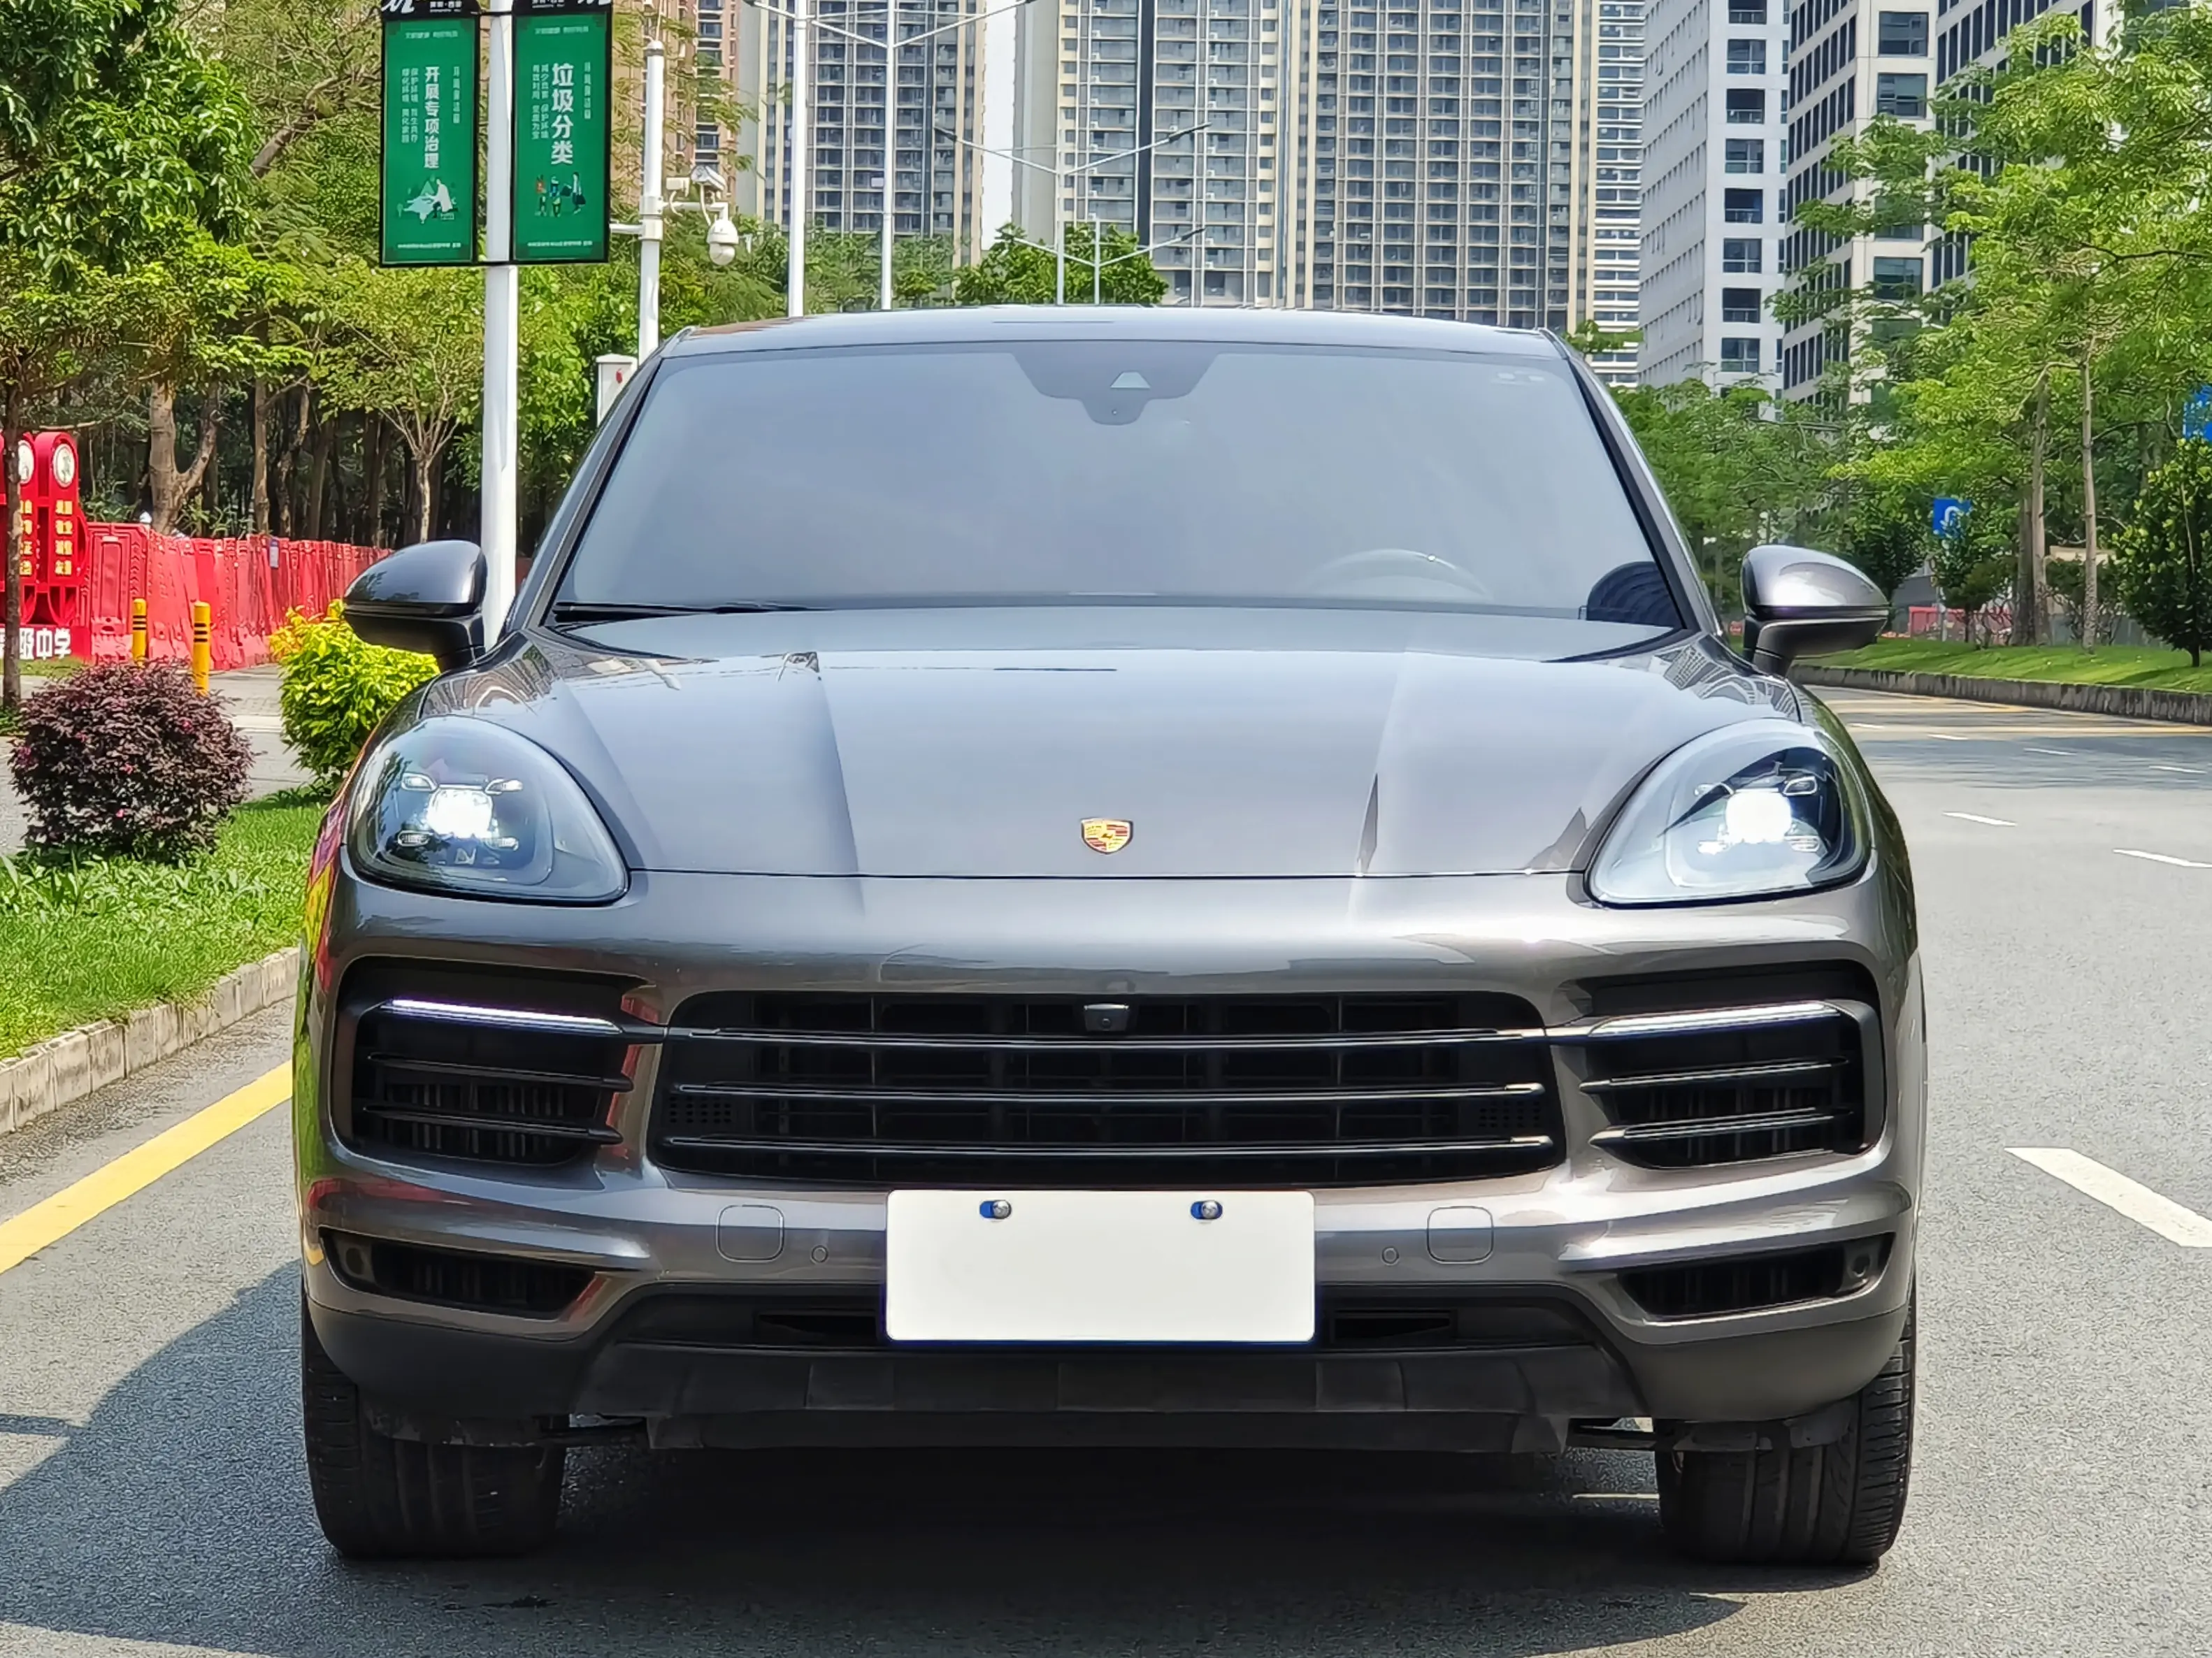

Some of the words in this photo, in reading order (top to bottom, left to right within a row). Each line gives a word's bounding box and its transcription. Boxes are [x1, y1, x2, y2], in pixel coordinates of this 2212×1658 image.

[424, 66, 440, 168] 开展专项治理
[551, 63, 574, 165] 垃圾分类
